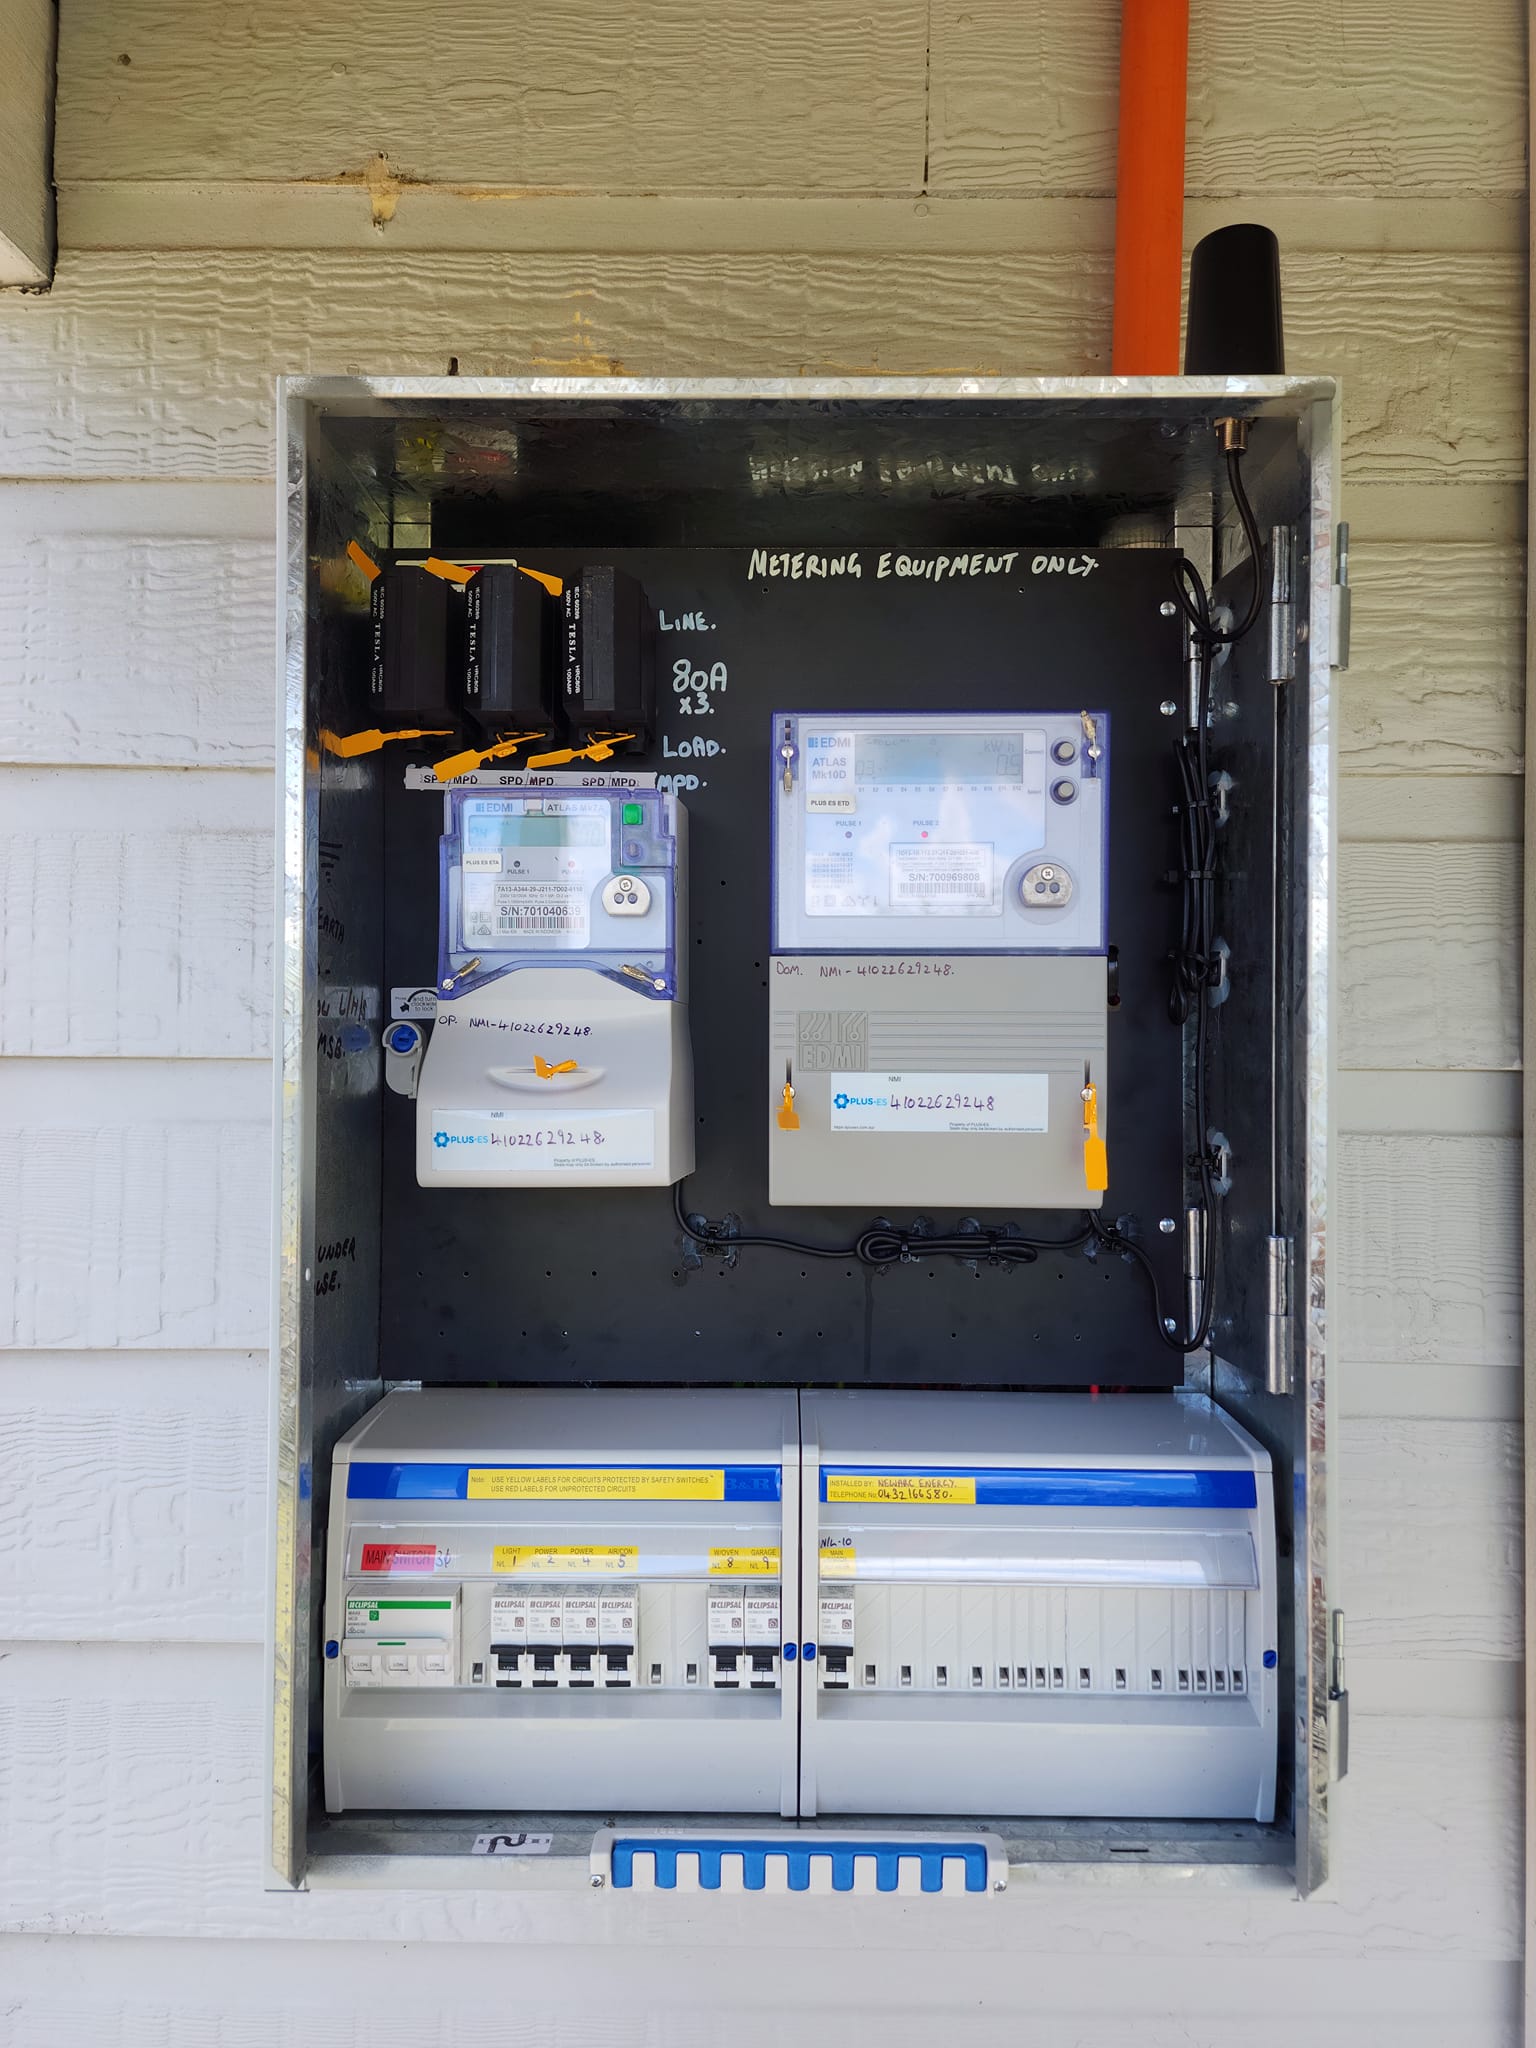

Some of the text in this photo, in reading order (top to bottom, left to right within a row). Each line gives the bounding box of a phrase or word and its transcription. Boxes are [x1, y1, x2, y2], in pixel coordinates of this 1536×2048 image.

[748, 550, 861, 580] METERING
[877, 552, 1019, 582] EQUIPMENT
[672, 658, 728, 693] 80A
[663, 735, 726, 758] LOAD.
[820, 737, 850, 748] EDMI
[812, 757, 846, 767] ATLAS
[423, 775, 478, 785] SP MPD
[812, 770, 846, 780] Mk10D
[500, 776, 554, 786] SPD MPD
[582, 777, 636, 787] SPD MPD
[657, 774, 708, 798] MPD.
[486, 803, 513, 812] EDMI
[501, 906, 581, 916] S/N:701040639
[802, 1044, 865, 1069] EDMI
[890, 1094, 995, 1111] 41022629248
[318, 1236, 355, 1263] UNDER
[367, 1550, 390, 1565] MAIN
[393, 1552, 431, 1564] SWITCH
[513, 1555, 516, 1566] 1
[547, 1555, 554, 1564] 2
[583, 1555, 591, 1566] 4
[618, 1554, 626, 1568] 5
[727, 1557, 734, 1568] 8
[762, 1556, 769, 1569] 9
